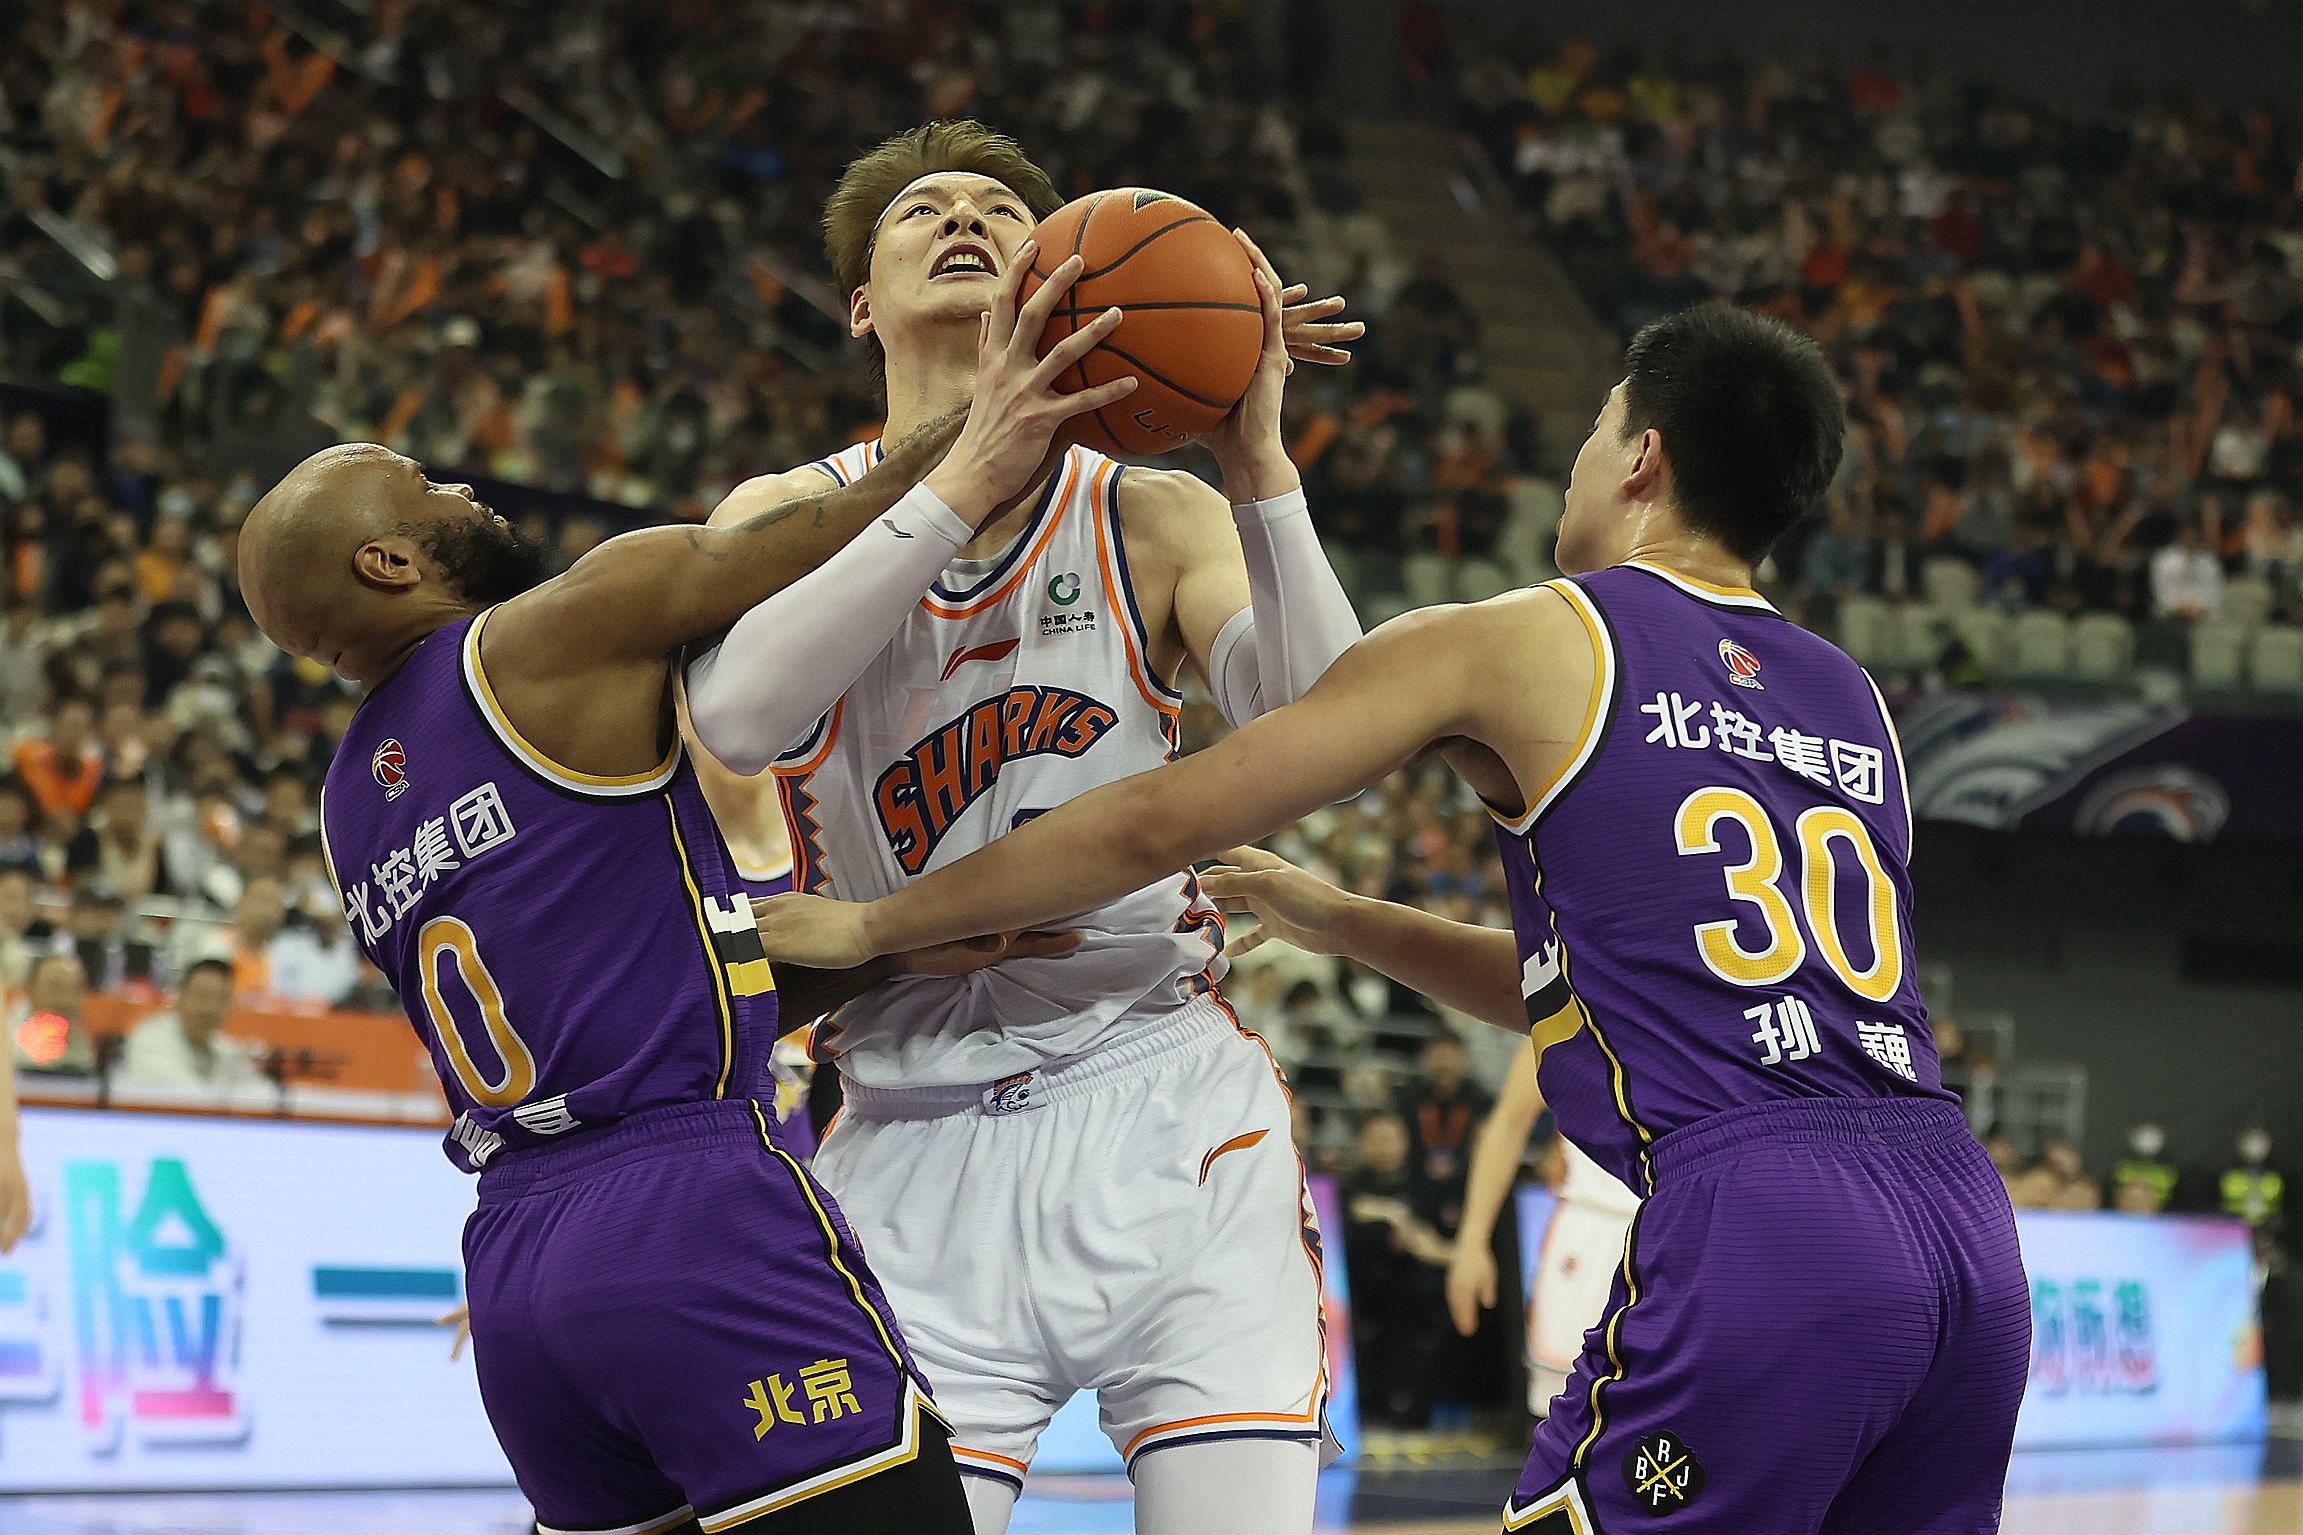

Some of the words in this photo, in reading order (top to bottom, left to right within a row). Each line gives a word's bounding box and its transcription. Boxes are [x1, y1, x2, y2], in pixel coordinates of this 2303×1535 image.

[1040, 611, 1095, 627] 中国人寿
[1043, 627, 1073, 636] CHINA
[1076, 624, 1096, 632] LIFE
[872, 684, 1120, 877] SHARKS
[1641, 692, 1884, 804] 北控集团
[346, 782, 516, 946] 北控集团
[1674, 786, 1903, 1002] 30
[418, 915, 537, 1107] 0
[743, 1358, 863, 1442] 北京
